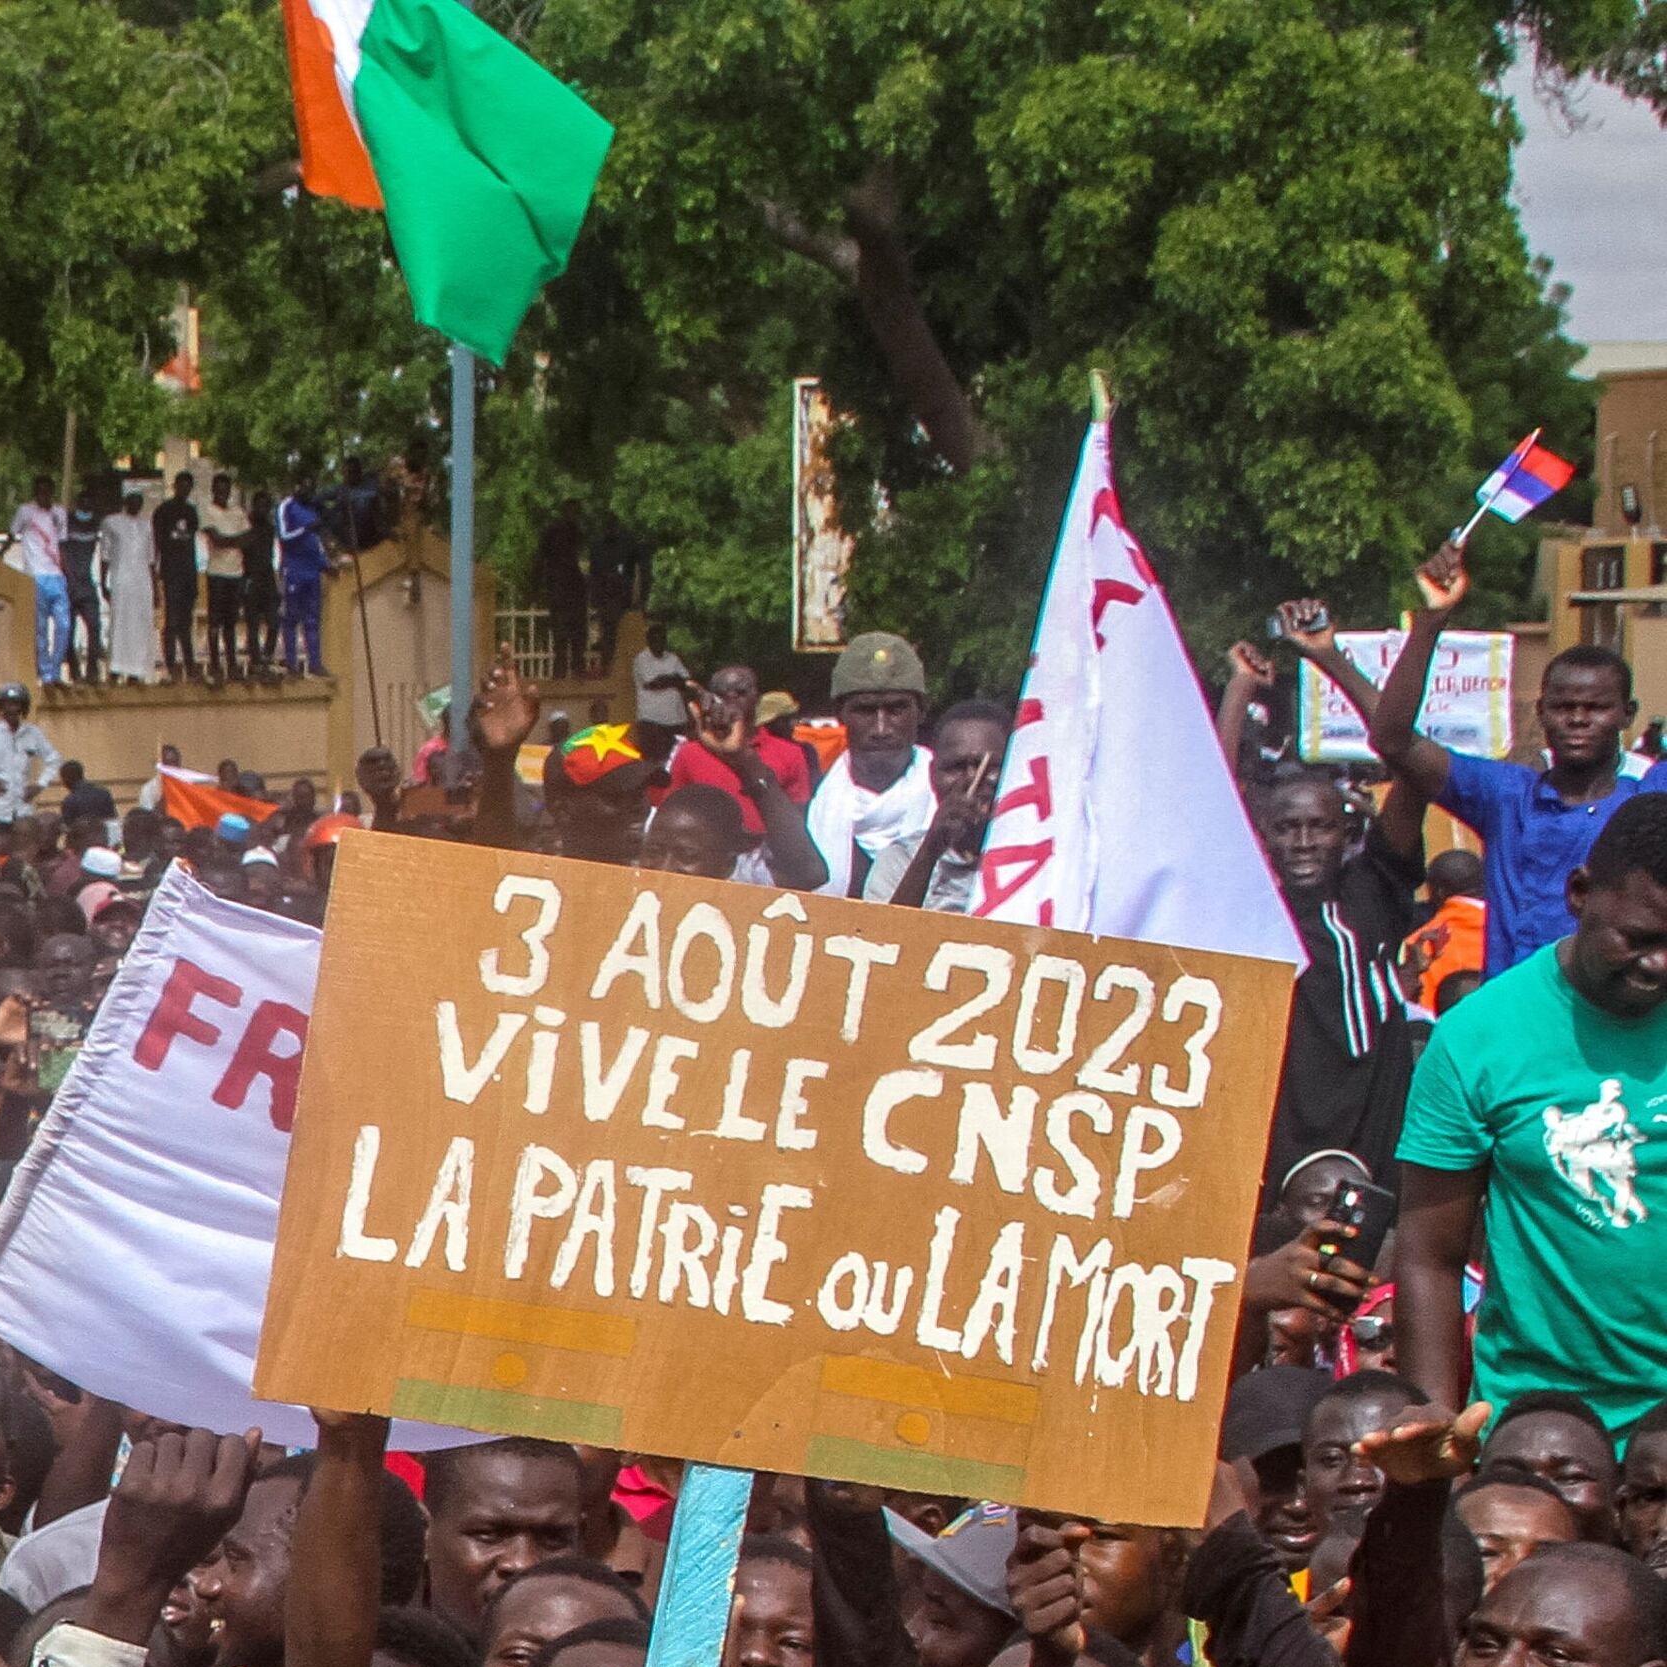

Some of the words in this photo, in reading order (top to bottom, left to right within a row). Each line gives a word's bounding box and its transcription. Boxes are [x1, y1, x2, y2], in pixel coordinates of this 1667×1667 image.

[479, 873, 563, 997] 3
[589, 889, 901, 1043] AOÛT
[907, 941, 1224, 1109] 2023
[717, 1046, 829, 1152] LE
[861, 1068, 1183, 1220] CNSP
[339, 1124, 476, 1273] LA
[916, 1204, 1027, 1366] LA
[1031, 1233, 1237, 1403] MORT
